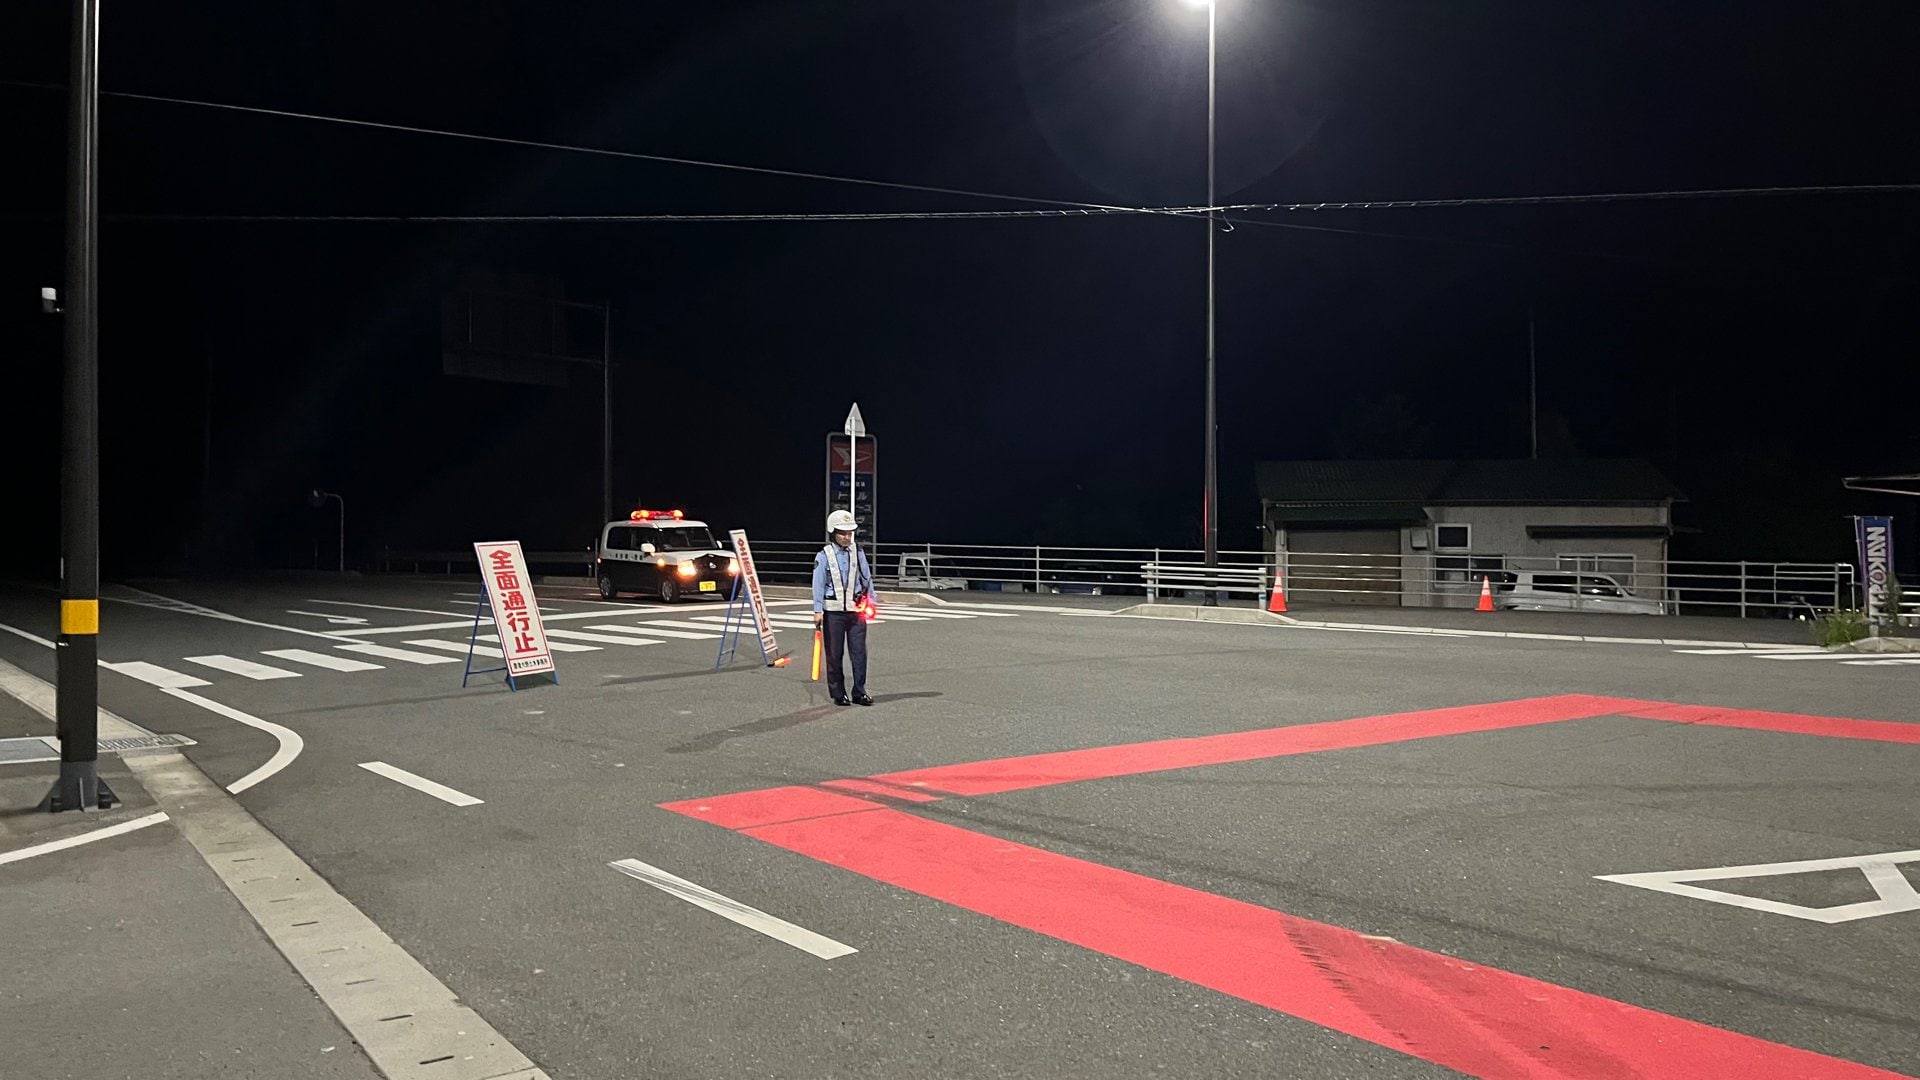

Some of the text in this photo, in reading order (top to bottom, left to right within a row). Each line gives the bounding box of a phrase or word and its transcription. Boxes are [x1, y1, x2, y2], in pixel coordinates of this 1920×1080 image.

[489, 549, 538, 654] 全面通行止
